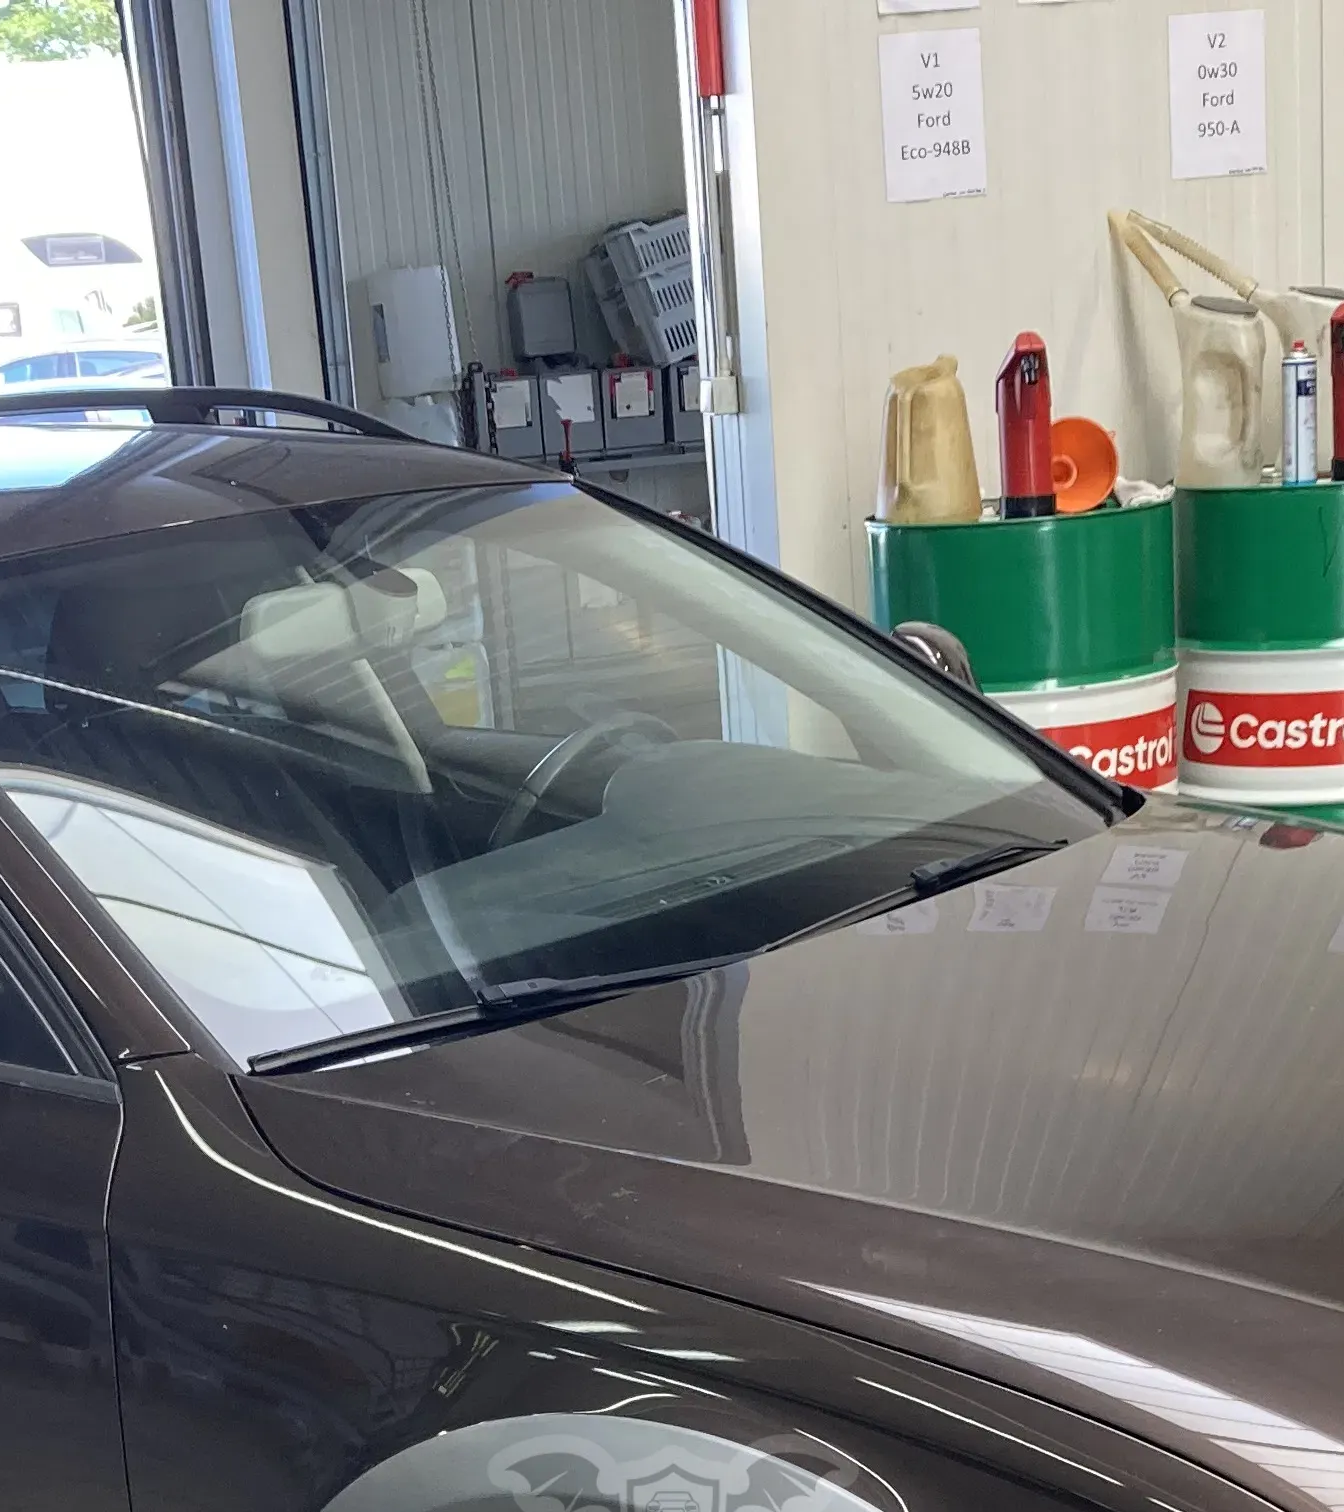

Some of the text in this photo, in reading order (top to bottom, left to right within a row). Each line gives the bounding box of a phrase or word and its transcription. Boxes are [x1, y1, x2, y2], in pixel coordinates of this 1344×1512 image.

[1207, 32, 1227, 49] V2
[920, 52, 940, 68] V1
[1197, 61, 1238, 80] 0w30
[912, 82, 953, 100] 5w20
[1202, 89, 1235, 107] Ford
[917, 110, 951, 128] Ford
[1198, 120, 1241, 138] 950-A
[901, 139, 971, 161] Eco-948B
